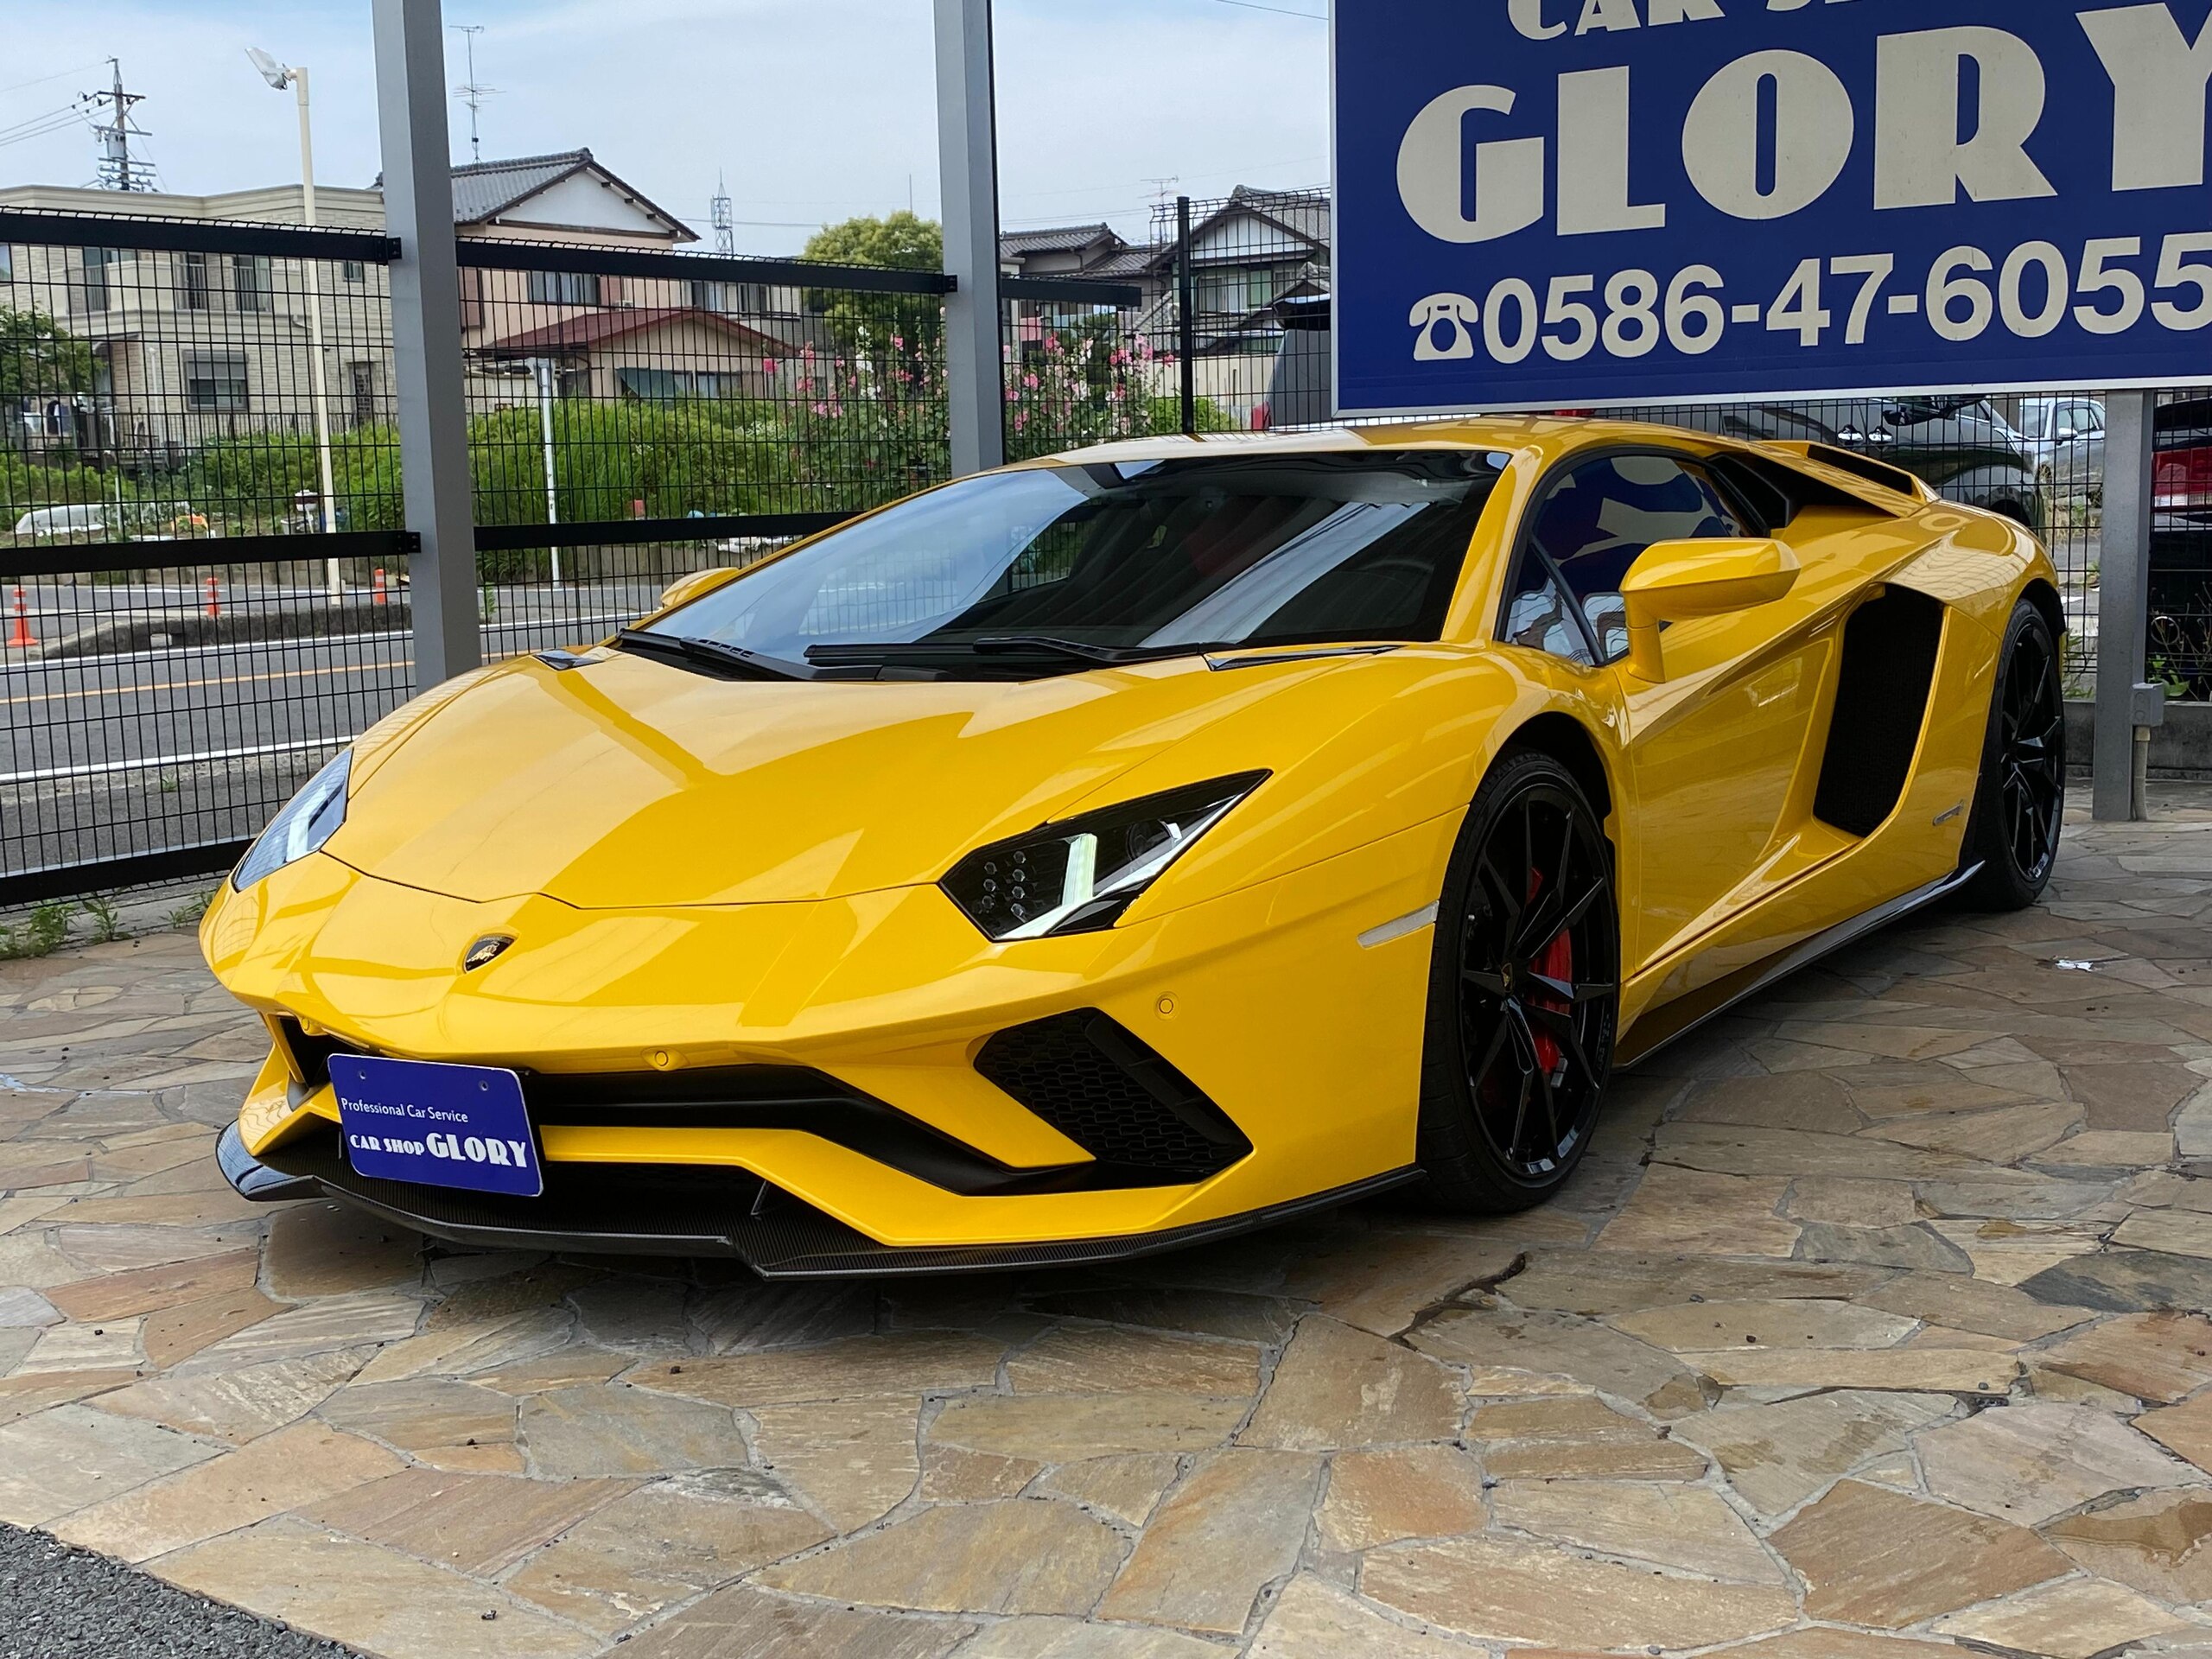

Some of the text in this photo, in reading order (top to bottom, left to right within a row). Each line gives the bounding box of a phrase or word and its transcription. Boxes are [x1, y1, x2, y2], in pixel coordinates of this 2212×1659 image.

[1396, 2, 2212, 244] GLORY
[1483, 232, 2212, 364] 0586-47-6055
[340, 1097, 469, 1123] Professional Car Service
[349, 1132, 528, 1168] CAR SHOP GLORY
